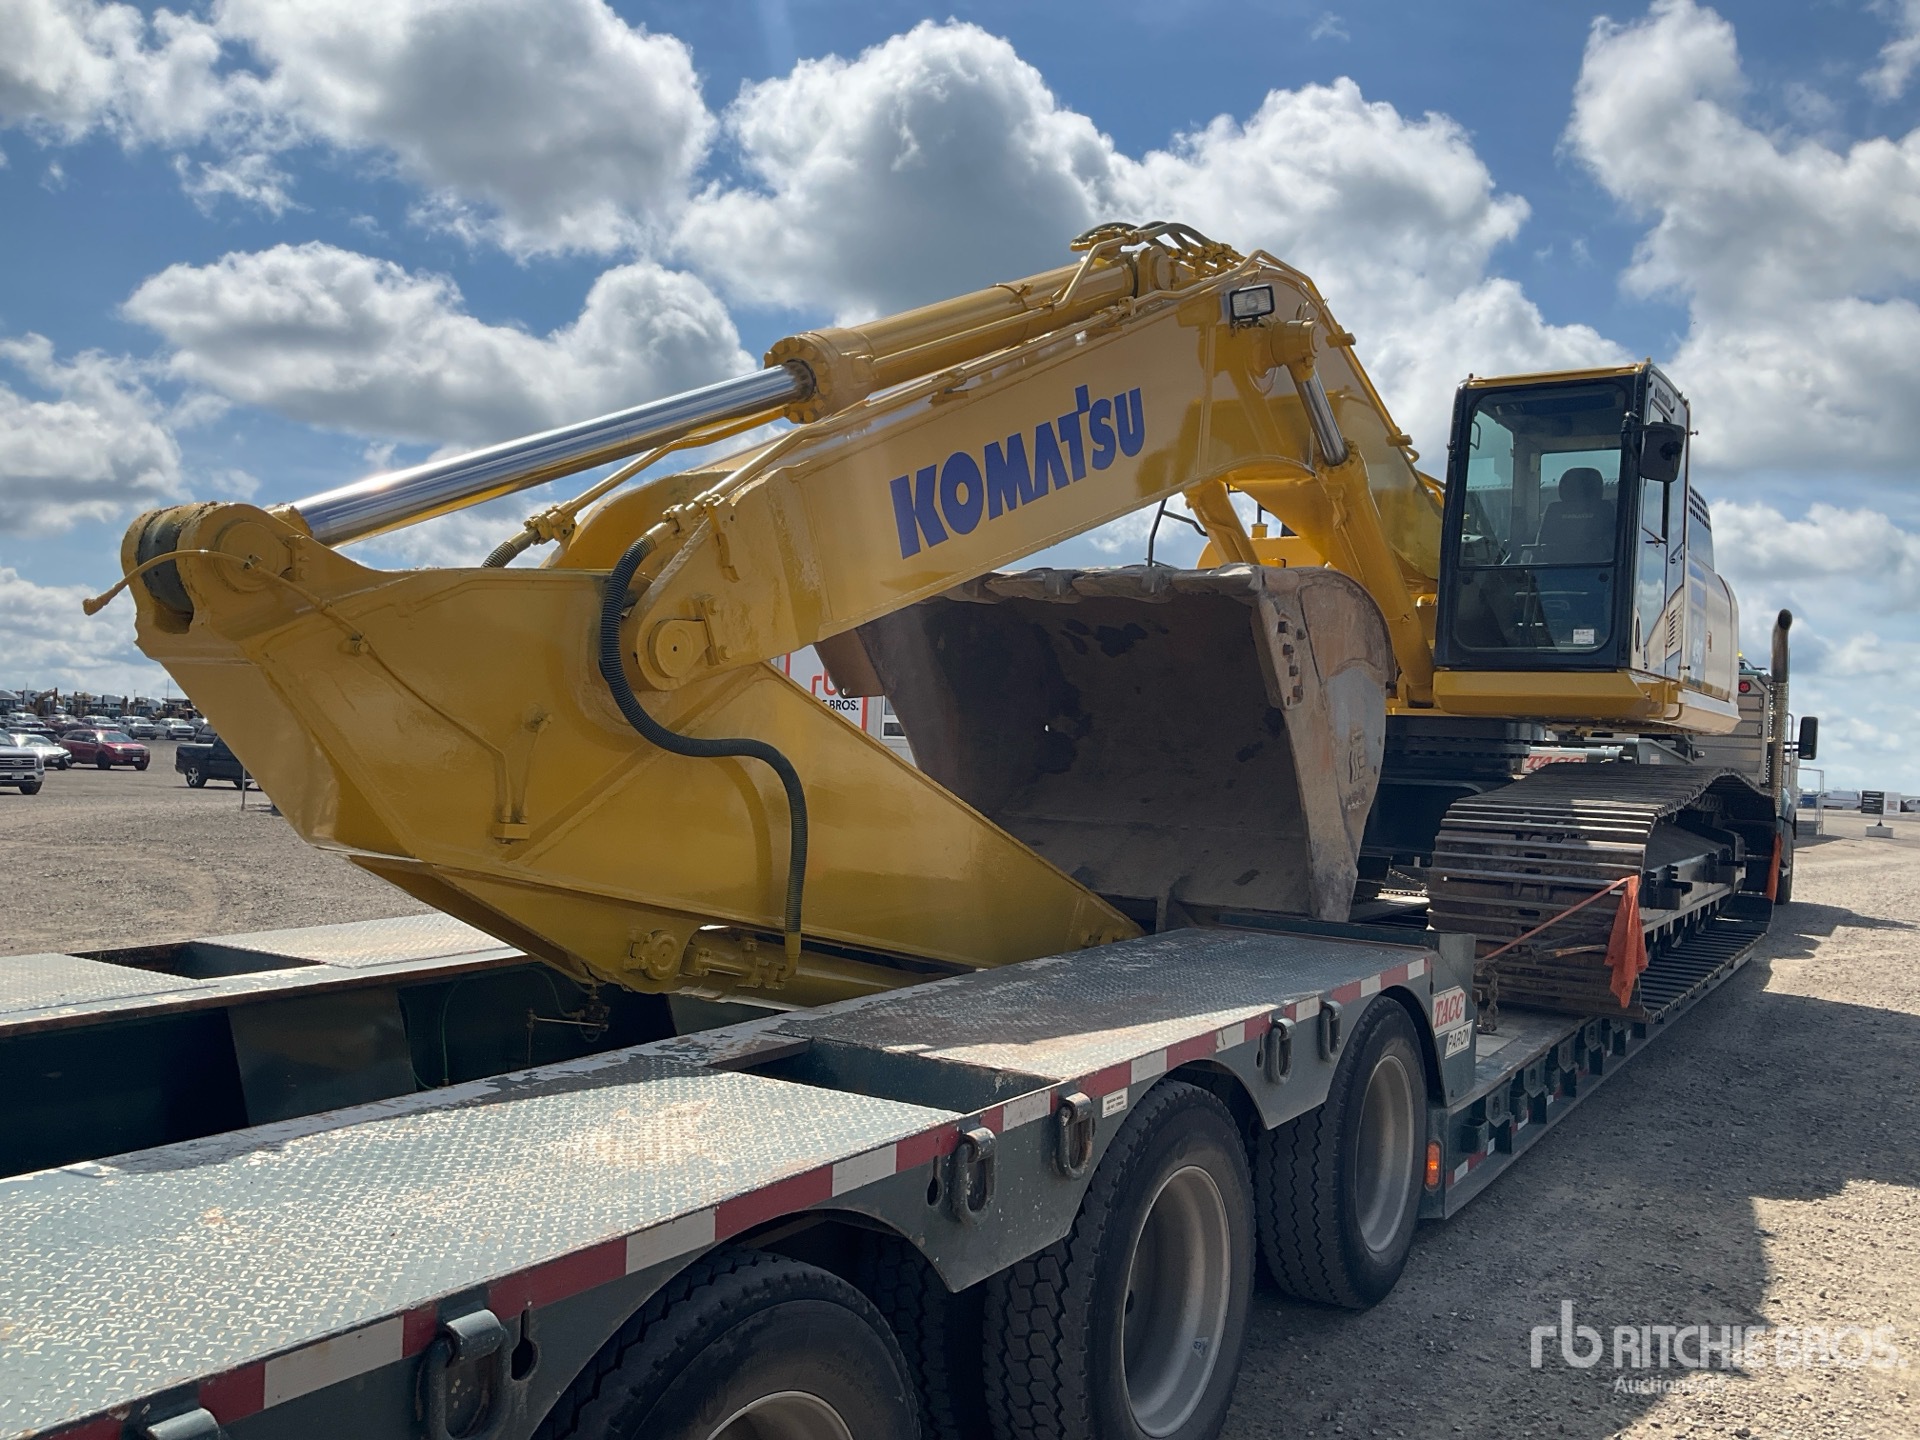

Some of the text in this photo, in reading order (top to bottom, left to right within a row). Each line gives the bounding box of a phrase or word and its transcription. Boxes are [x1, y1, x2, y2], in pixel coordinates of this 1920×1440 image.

[890, 384, 1145, 560] KOMATSU
[829, 699, 859, 711] BROS.
[1434, 992, 1465, 1028] TACC
